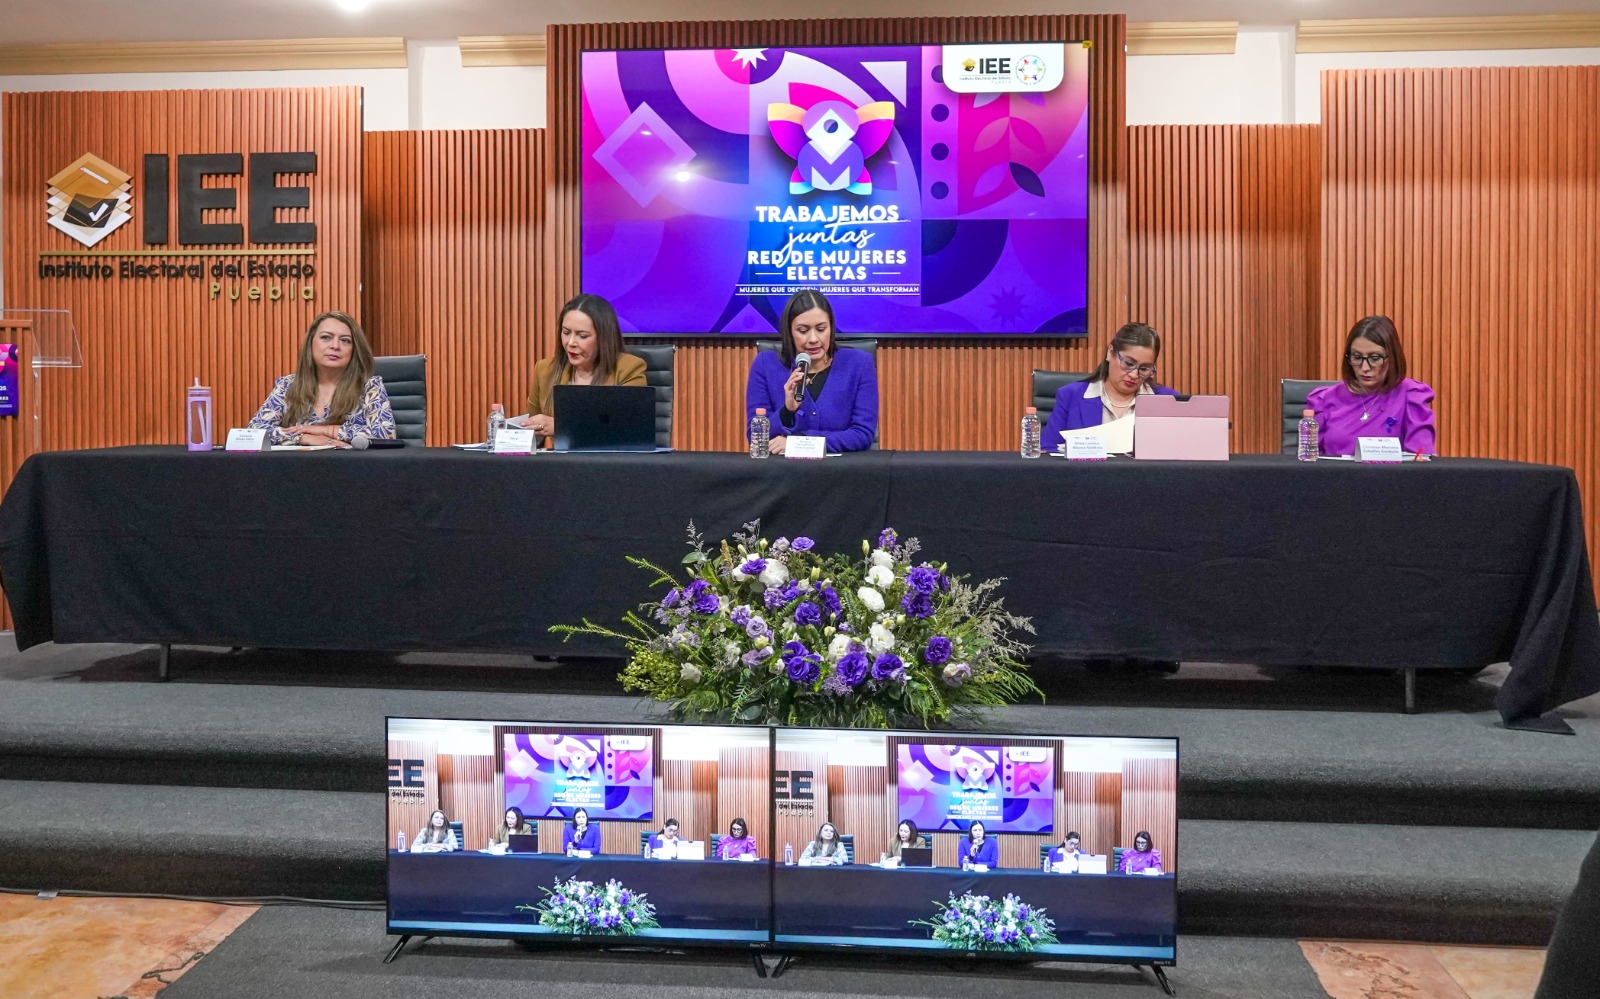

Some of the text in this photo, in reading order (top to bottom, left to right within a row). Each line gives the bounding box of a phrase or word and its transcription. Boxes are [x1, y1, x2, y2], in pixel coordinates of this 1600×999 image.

[979, 58, 1011, 74] IEE
[143, 152, 316, 245] IEE
[755, 204, 899, 223] TRABAJEMOS
[775, 221, 877, 268] juntas
[747, 250, 907, 265] RED DE MUJERES
[39, 260, 315, 279] Instituto Electoral del Estado
[786, 266, 867, 280] ELECTAS
[210, 281, 314, 300] Puebla
[388, 759, 424, 787] EE
[775, 771, 813, 800] EE
